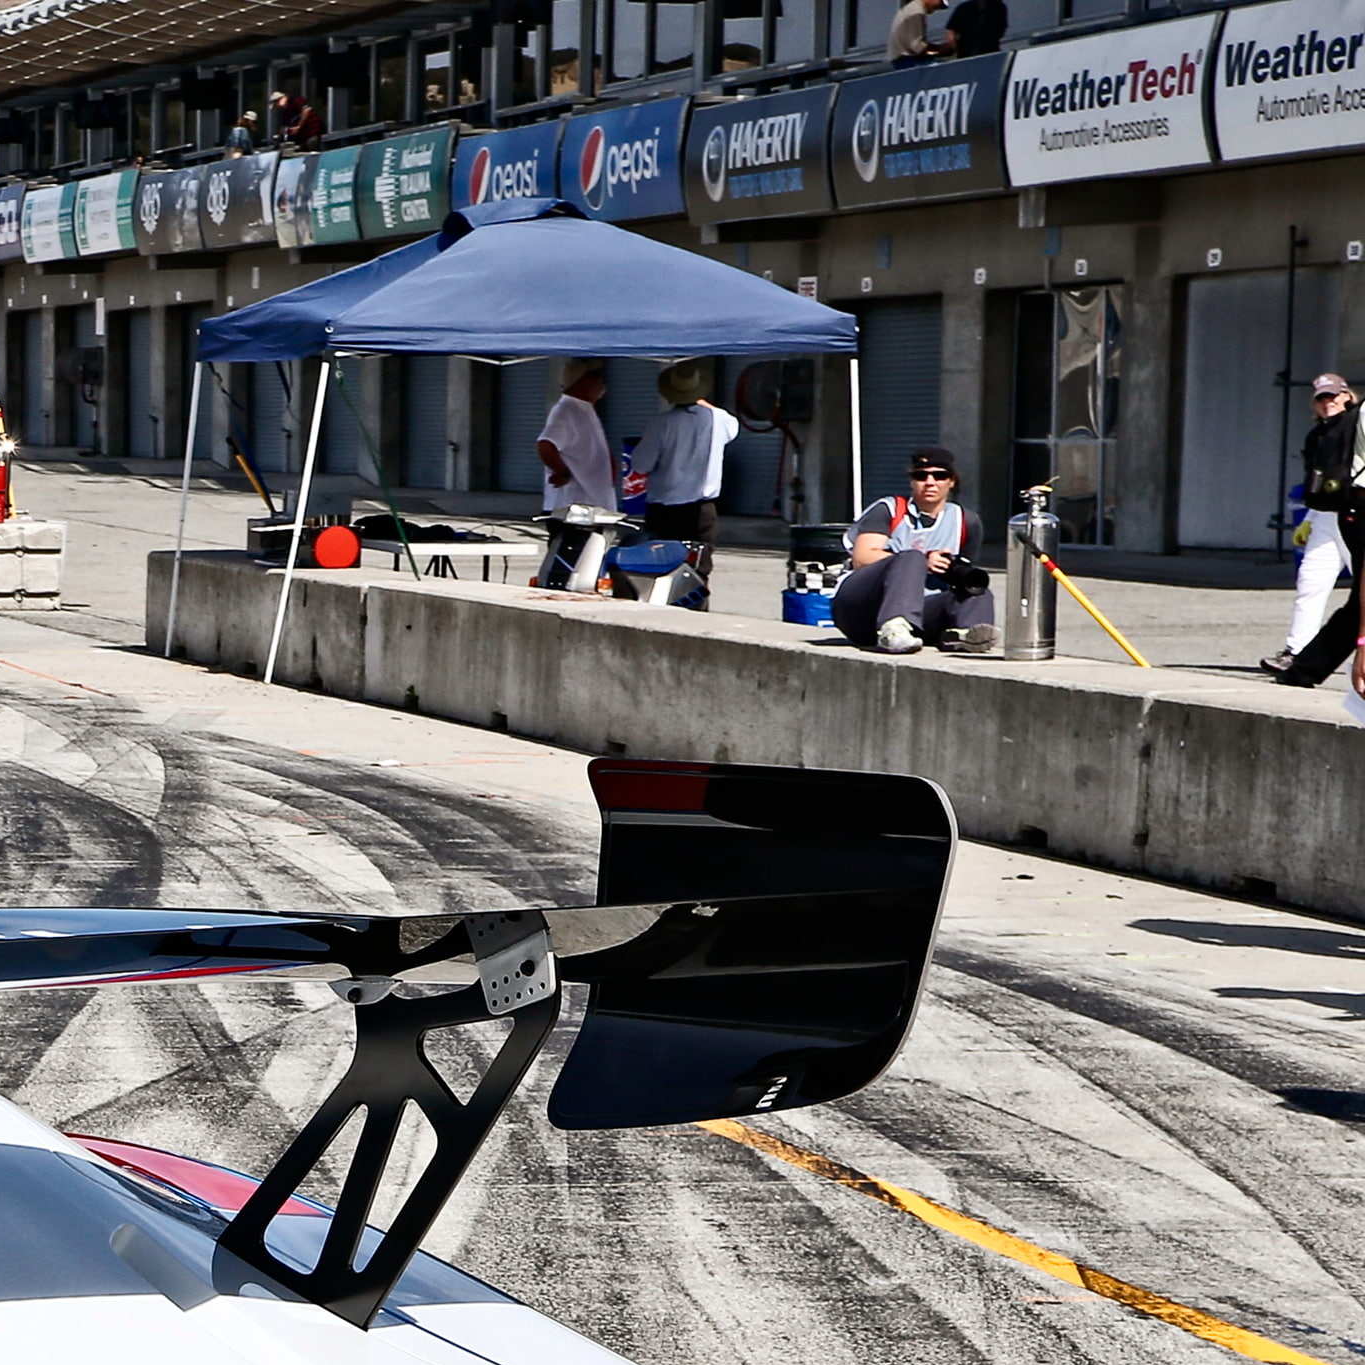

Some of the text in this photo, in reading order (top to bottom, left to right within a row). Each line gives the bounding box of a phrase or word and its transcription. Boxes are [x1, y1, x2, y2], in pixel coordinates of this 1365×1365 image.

[882, 82, 978, 147] HAGERTY
[1012, 53, 1197, 120] WeatherTech
[1255, 89, 1330, 123] Automotive
[606, 127, 660, 197] pepsi
[727, 112, 809, 169] HAGERTY
[1039, 112, 1170, 151] Automotive Accessories
